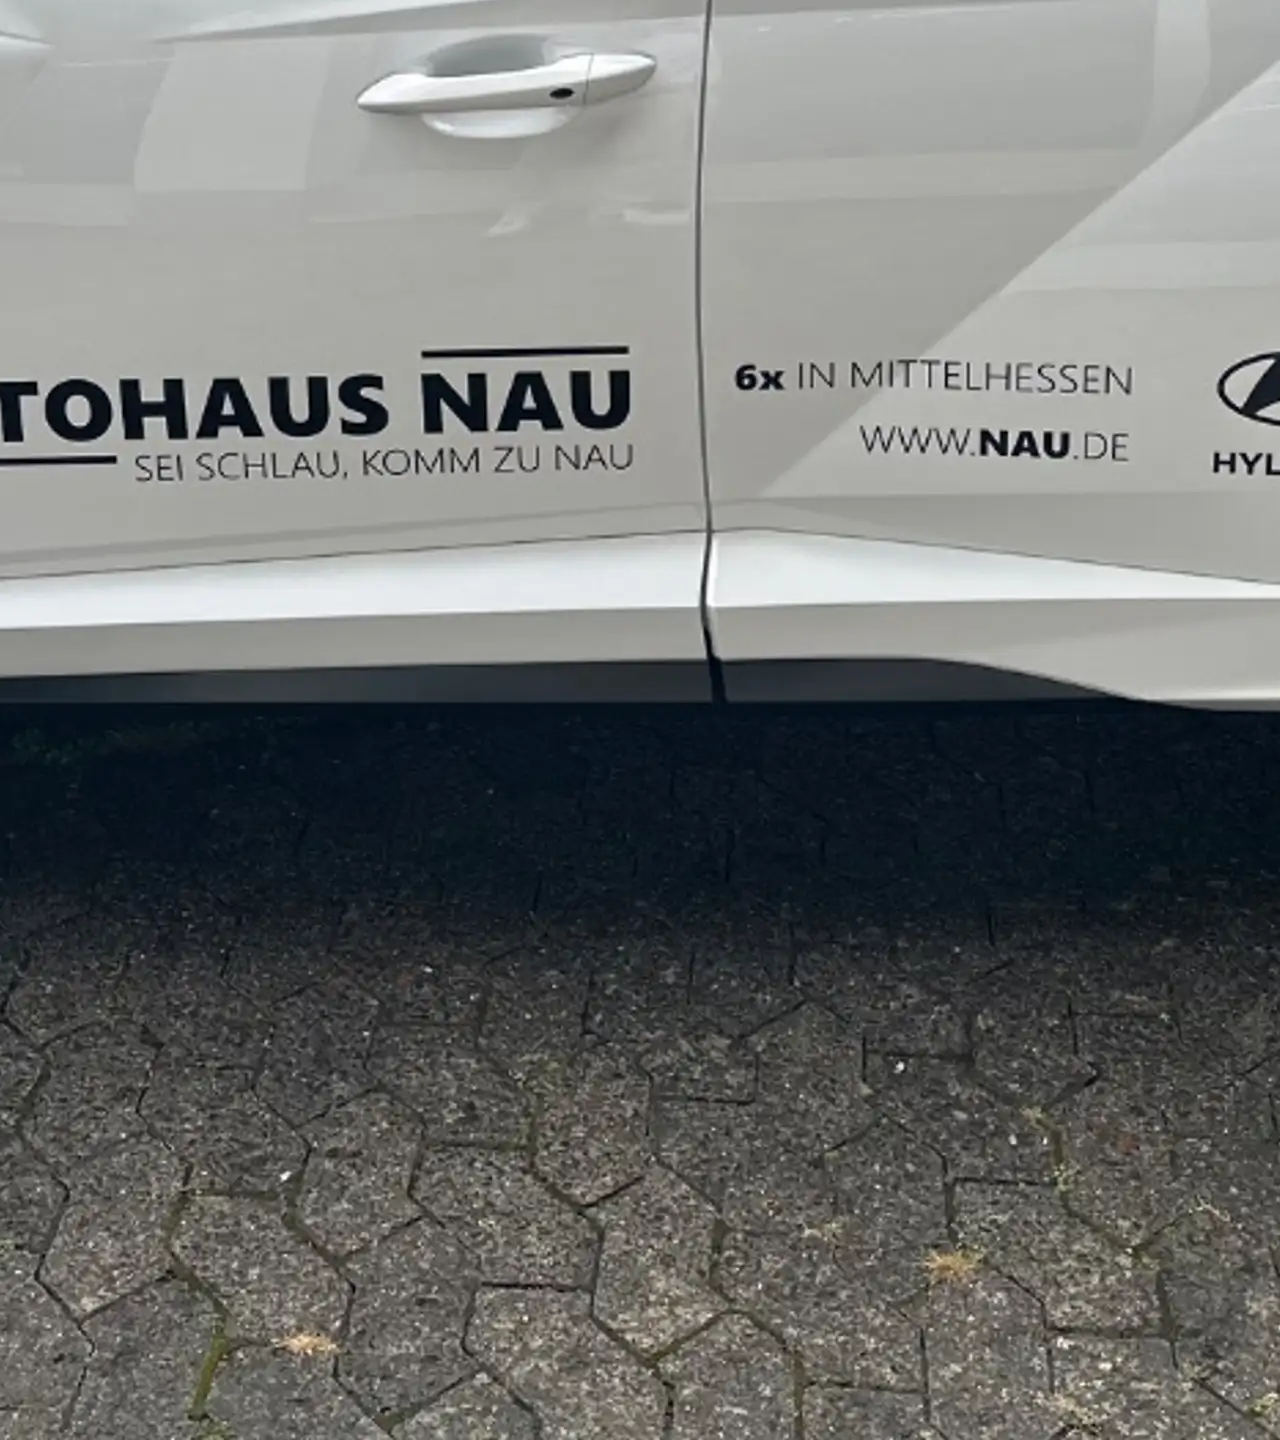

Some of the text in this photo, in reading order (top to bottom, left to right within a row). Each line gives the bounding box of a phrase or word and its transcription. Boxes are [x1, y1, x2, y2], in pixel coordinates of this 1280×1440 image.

[733, 358, 1134, 397] 6x IN MITTELHESSEN
[419, 368, 633, 436] NAU
[134, 443, 635, 483] SEI SCHLAU, KOMM ZU NAU
[858, 424, 1131, 464] WWW.NAU.DE
